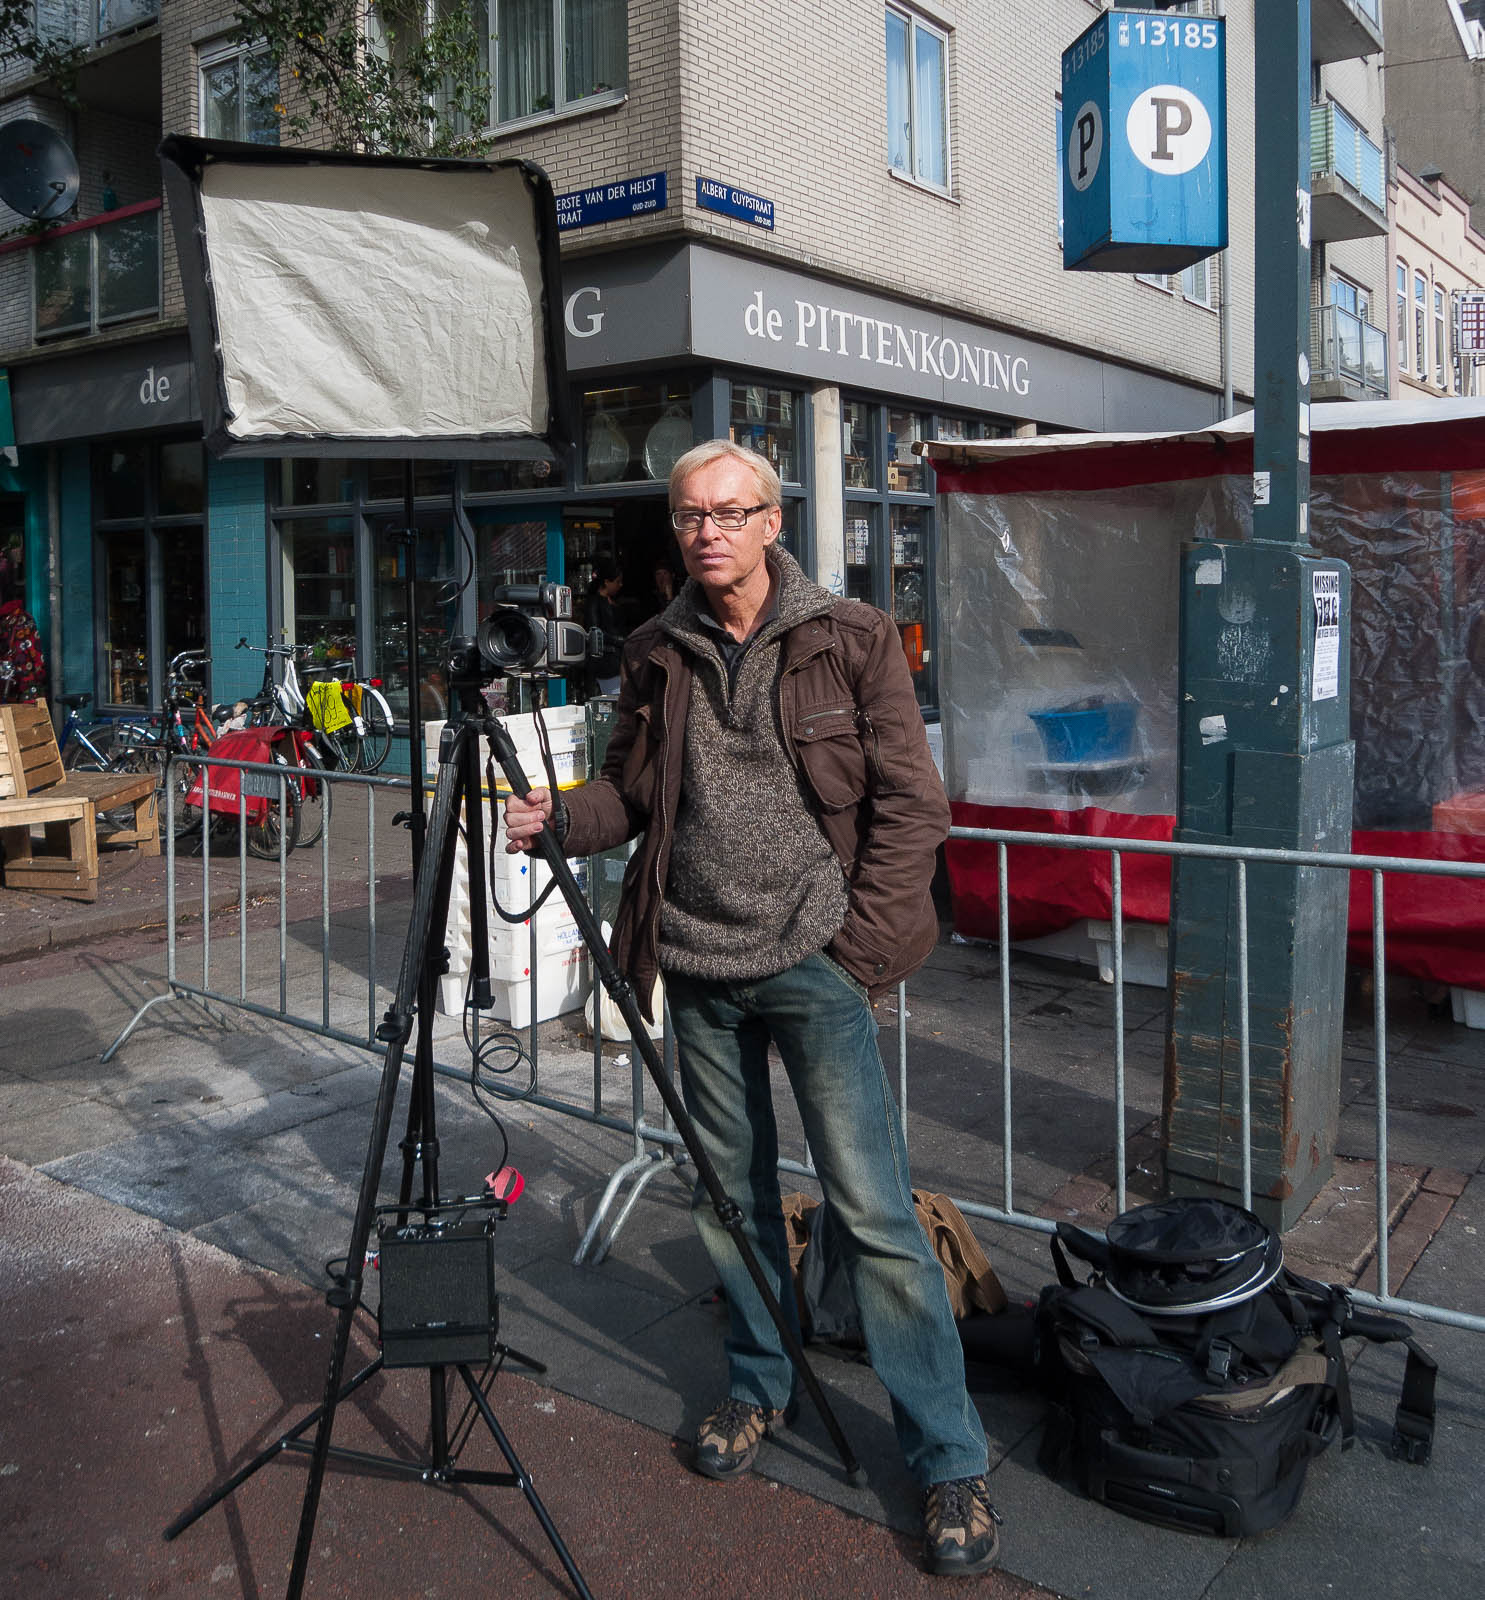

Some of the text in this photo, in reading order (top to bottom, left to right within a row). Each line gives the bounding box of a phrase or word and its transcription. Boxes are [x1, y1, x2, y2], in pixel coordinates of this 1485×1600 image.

[1071, 24, 1106, 74] 13185
[1135, 20, 1217, 49] 13185
[1077, 111, 1096, 181] P
[1150, 97, 1193, 160] P
[556, 178, 657, 212] ERSTE VAN DER HELST
[632, 199, 657, 212] OUD-ZUID
[701, 181, 772, 216] ALBERT CUYPSTRAAT
[557, 209, 583, 226] TRAAT
[744, 290, 1031, 396] de PITTENKONING
[140, 365, 170, 405] de
[1314, 575, 1338, 594] MISSING
